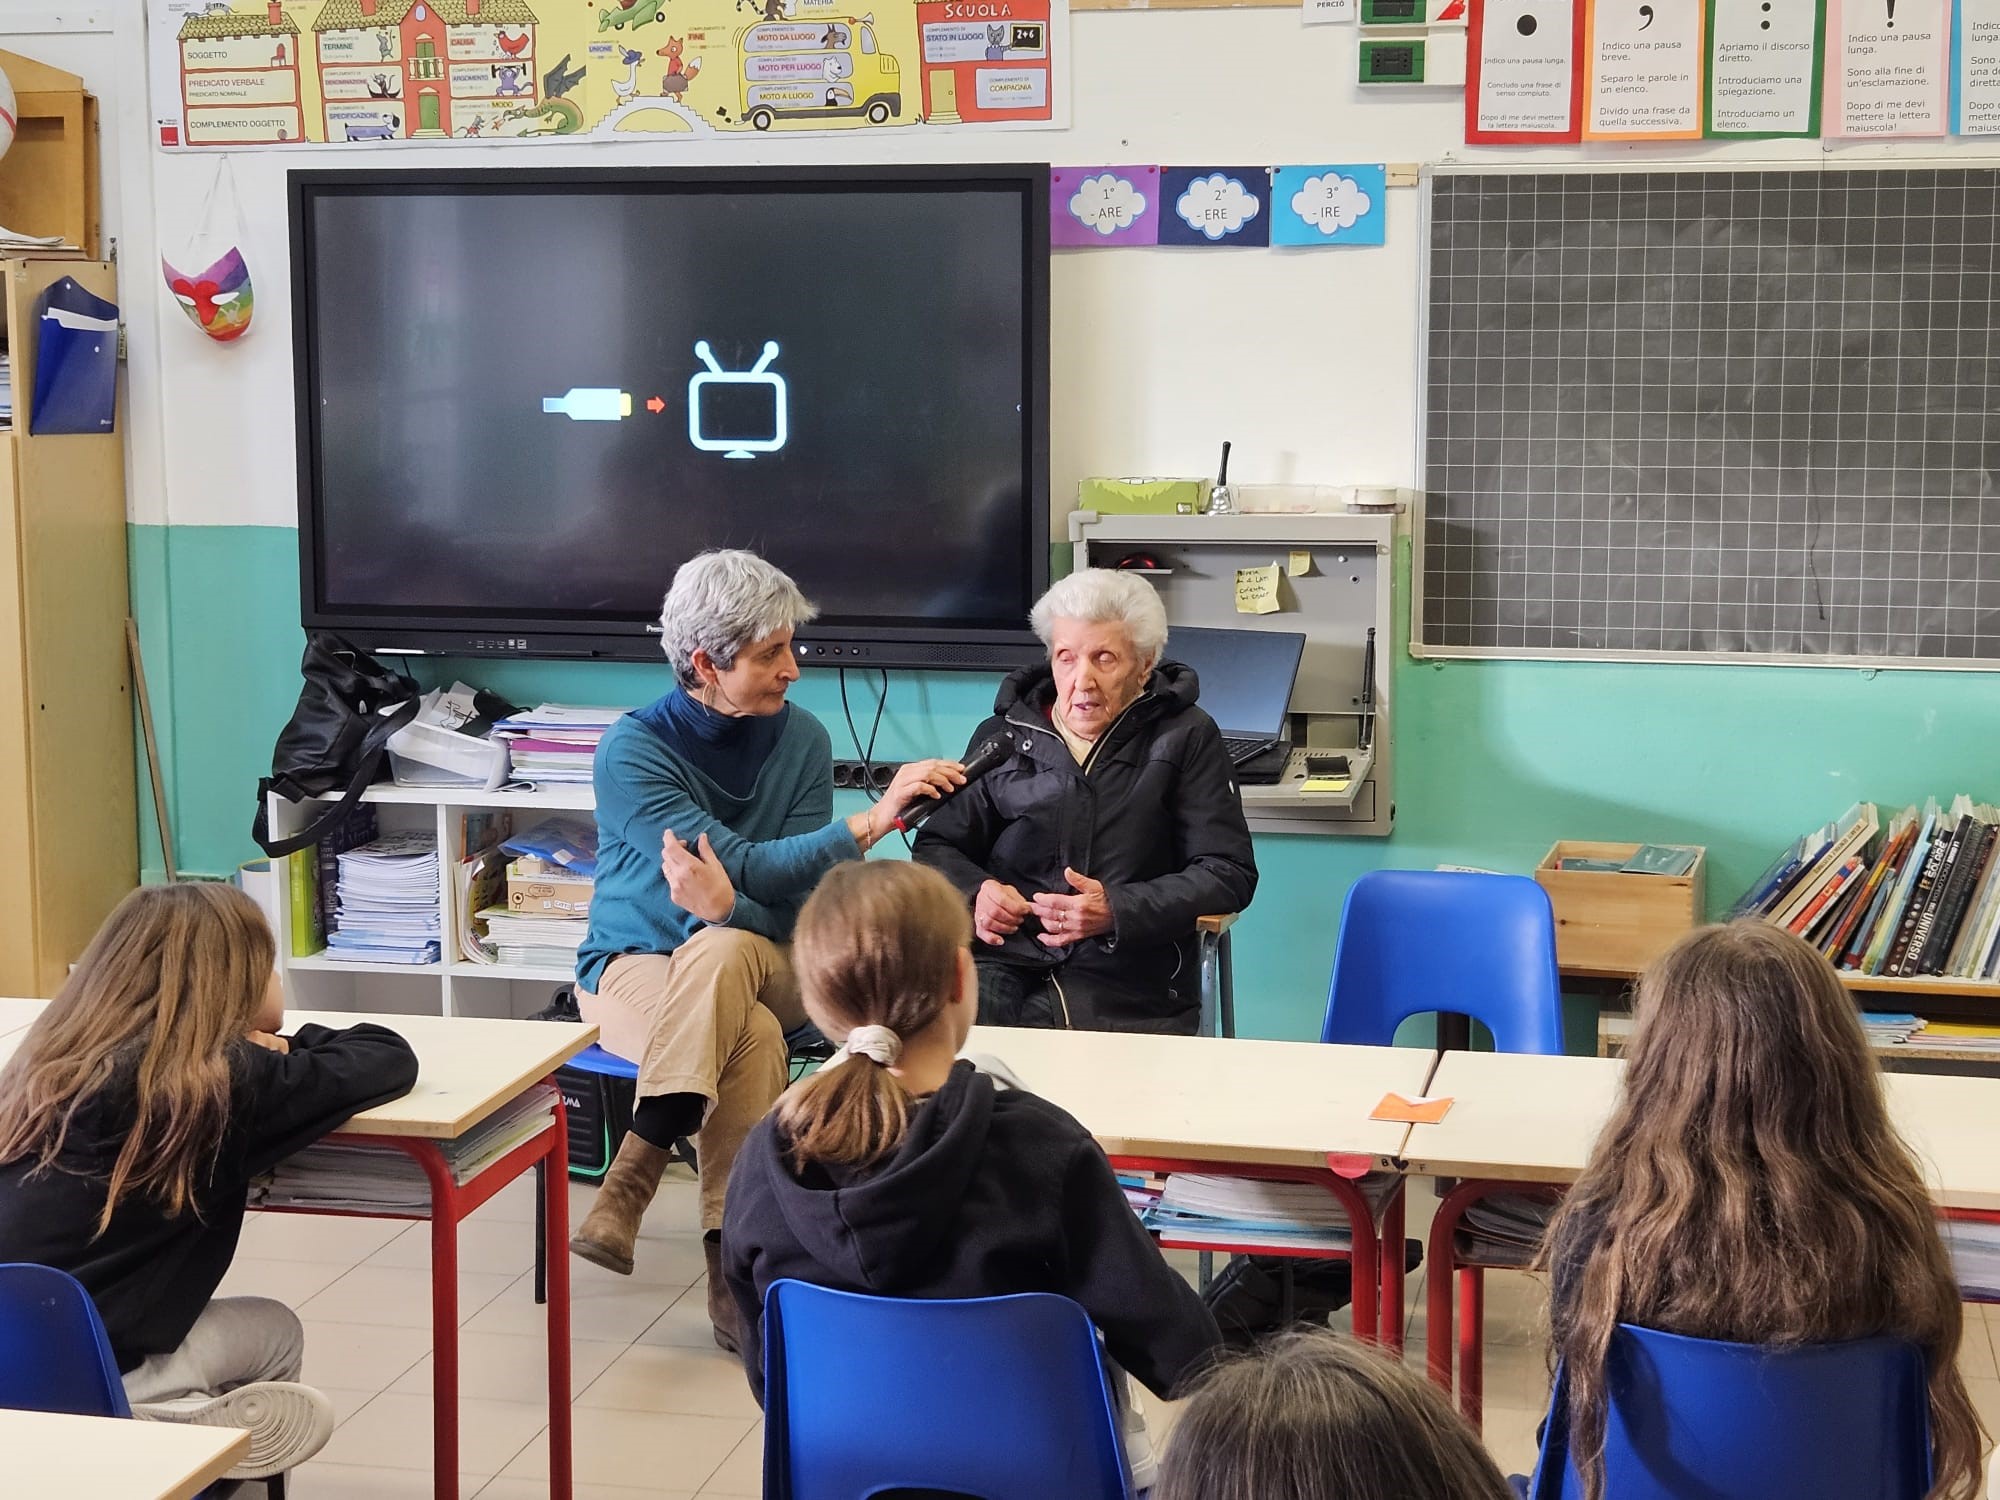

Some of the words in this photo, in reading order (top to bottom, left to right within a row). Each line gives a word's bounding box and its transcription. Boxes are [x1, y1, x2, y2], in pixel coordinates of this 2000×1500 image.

[945, 4, 1012, 18] SCUOLA
[1017, 30, 1034, 39] 2+6
[1902, 34, 1931, 42] pausa
[1602, 42, 1630, 50] Indico
[1654, 42, 1681, 50] pausa
[1720, 44, 1758, 52] Apriamo
[1848, 46, 1876, 55] lunga.
[1971, 57, 1995, 65] Sono
[1848, 68, 1871, 77] Sono
[1601, 75, 1633, 83] Separo
[1649, 74, 1677, 83] parole
[1847, 78, 1929, 88] un'esclamazione.
[990, 84, 1032, 92] COMPAGNIA
[1718, 88, 1776, 97] spiegazione.
[1847, 102, 1870, 111] Dopo
[1875, 101, 1883, 109] di
[1969, 102, 1994, 111] Dopo
[1846, 124, 1896, 132] maiuscola!
[1928, 840, 1949, 878] SOLARE
[1907, 912, 1934, 960] UNIVERSO
